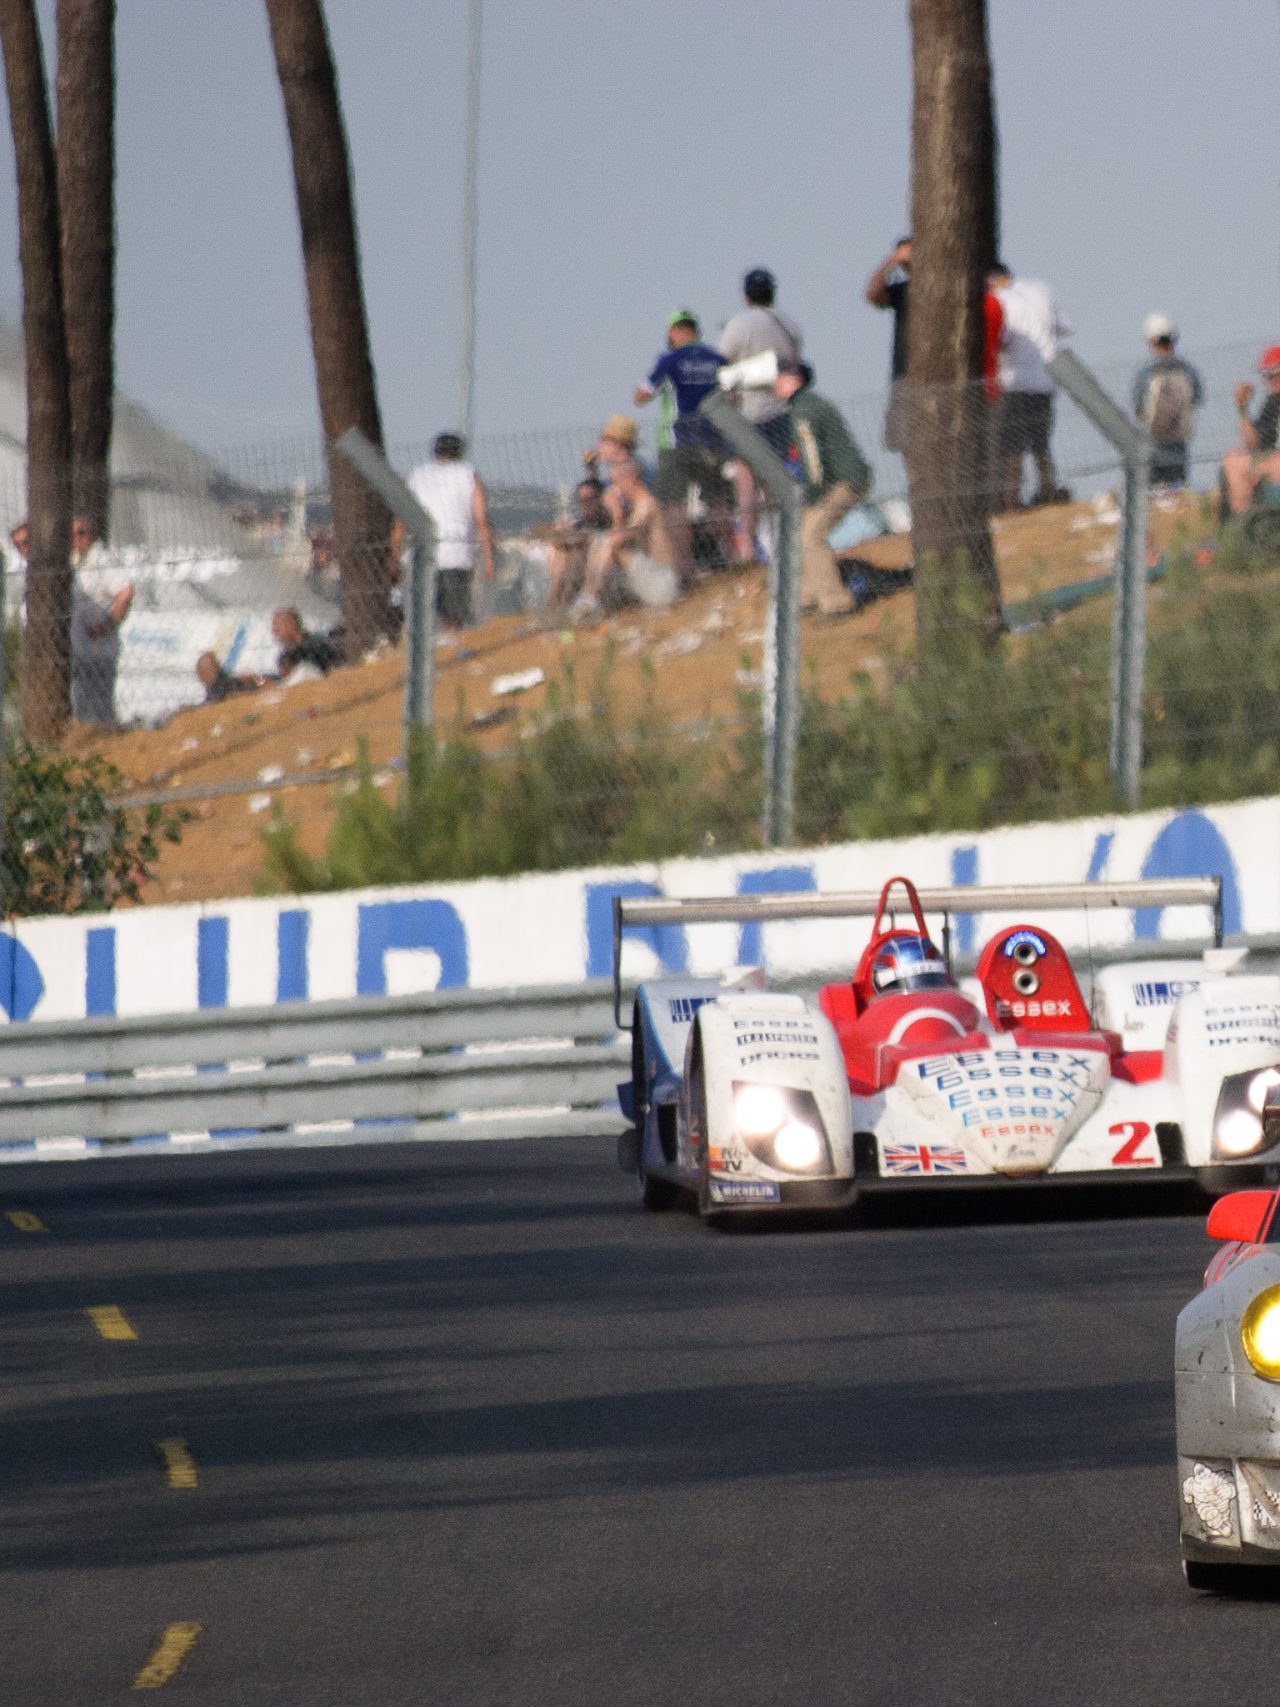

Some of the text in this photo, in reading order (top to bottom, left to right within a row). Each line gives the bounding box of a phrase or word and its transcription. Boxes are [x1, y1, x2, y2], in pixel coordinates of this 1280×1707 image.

[995, 999, 1072, 1018] Essex
[918, 1050, 1091, 1080] Essex
[937, 1066, 1081, 1091] Essex
[949, 1085, 1077, 1110] Essex
[962, 1105, 1067, 1128] Essex
[1108, 1120, 1155, 1166] 2
